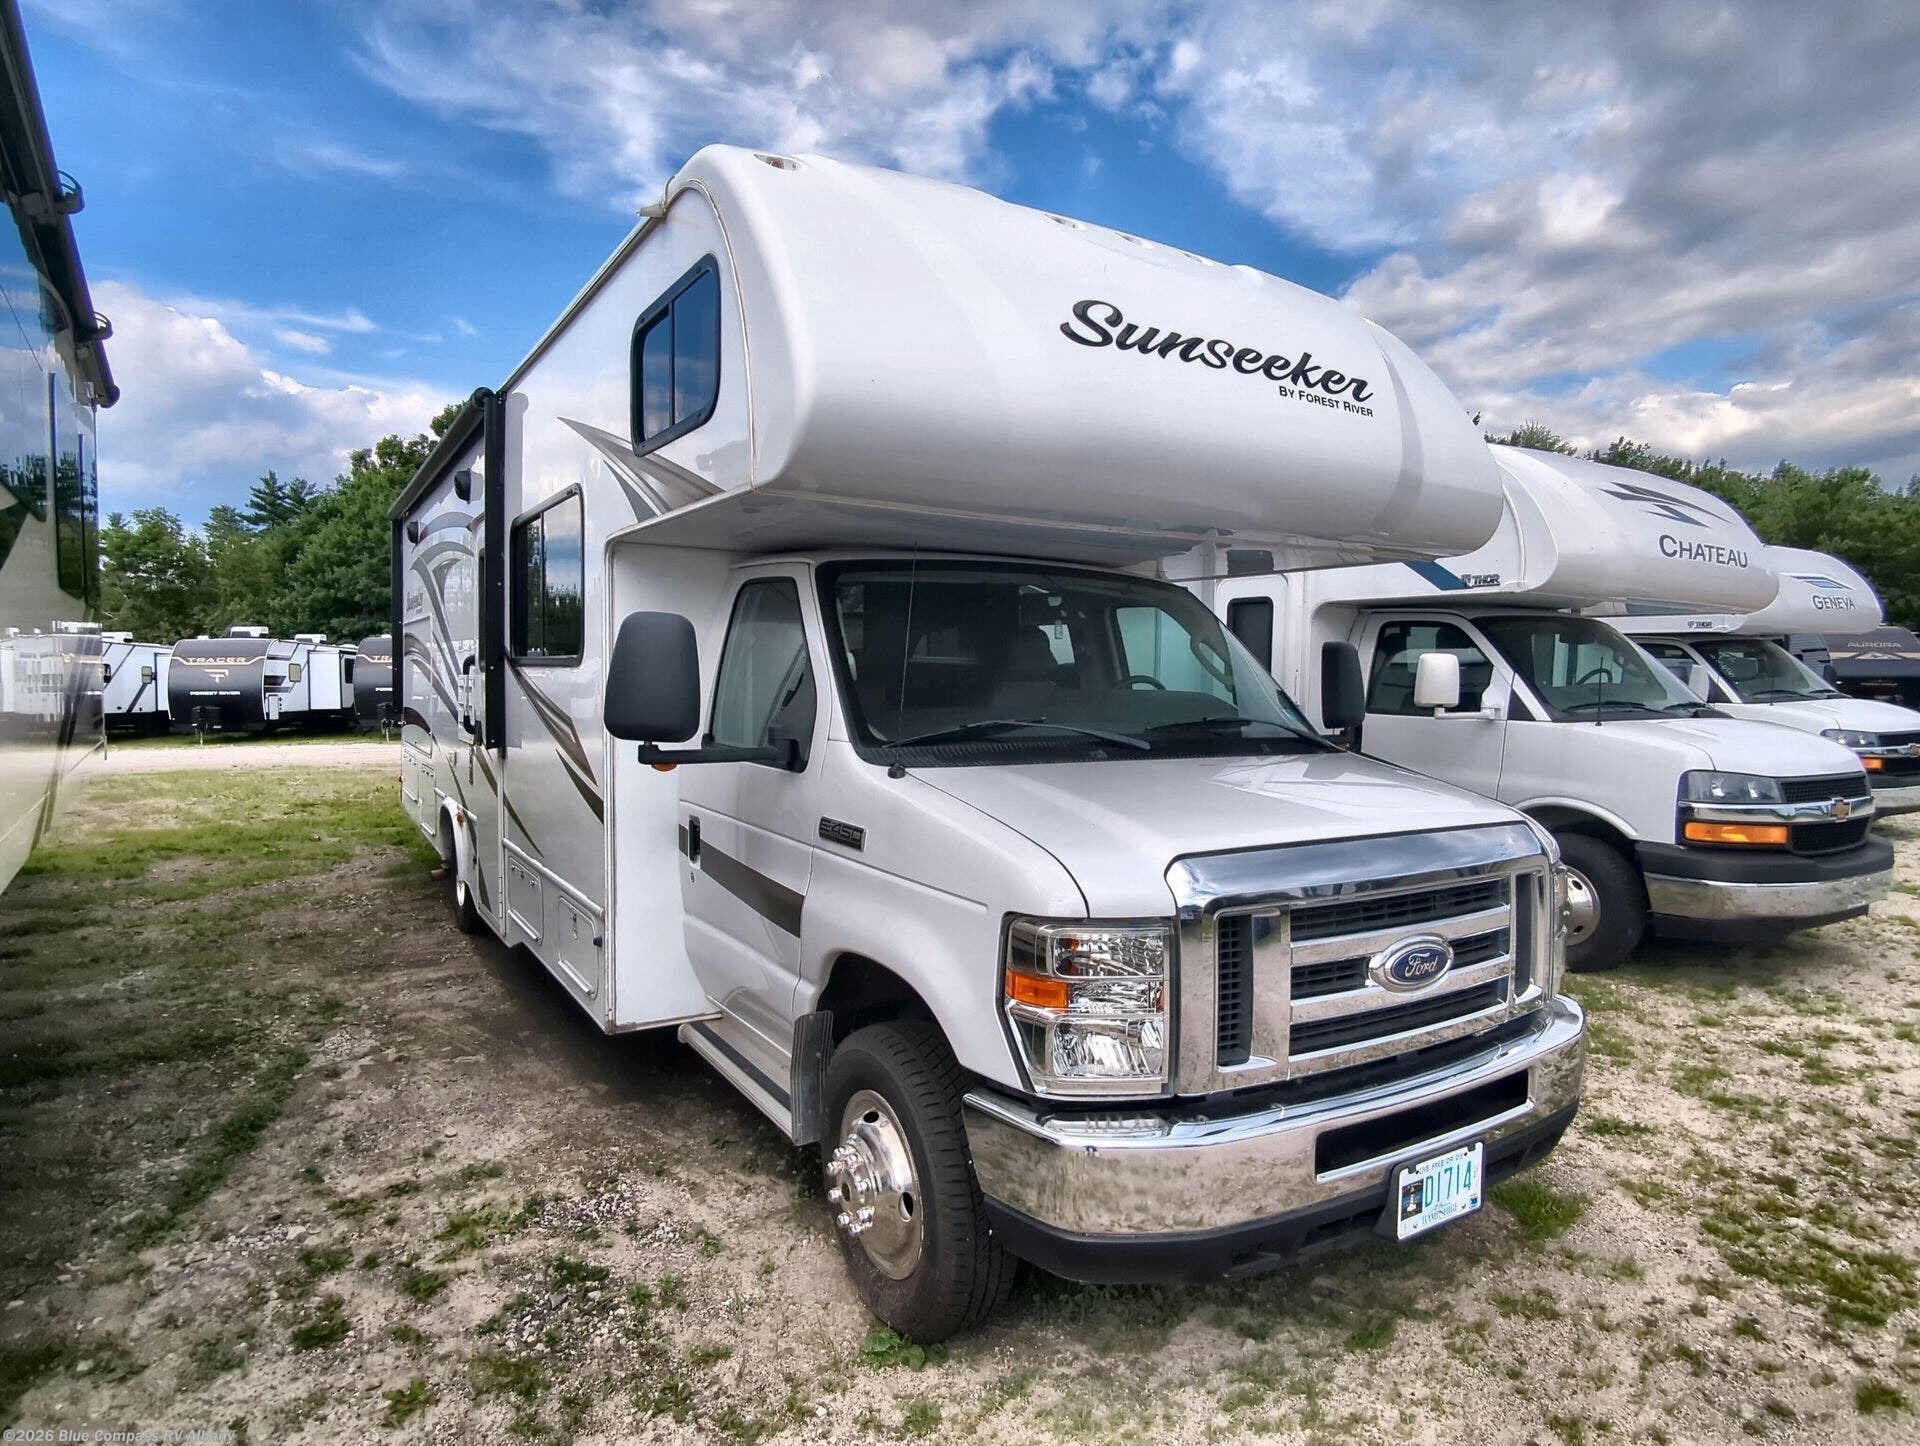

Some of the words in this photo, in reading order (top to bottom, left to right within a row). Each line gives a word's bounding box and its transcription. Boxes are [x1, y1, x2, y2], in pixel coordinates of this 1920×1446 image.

[1060, 299, 1374, 403] Sunseeker
[1279, 385, 1295, 399] BY
[1298, 390, 1340, 409] FOREST
[1343, 401, 1374, 418] RIVER
[1659, 534, 1749, 569] CHATEAU
[1471, 573, 1501, 585] THOR
[1812, 595, 1856, 611] GENEVA
[1404, 951, 1439, 977] Ford
